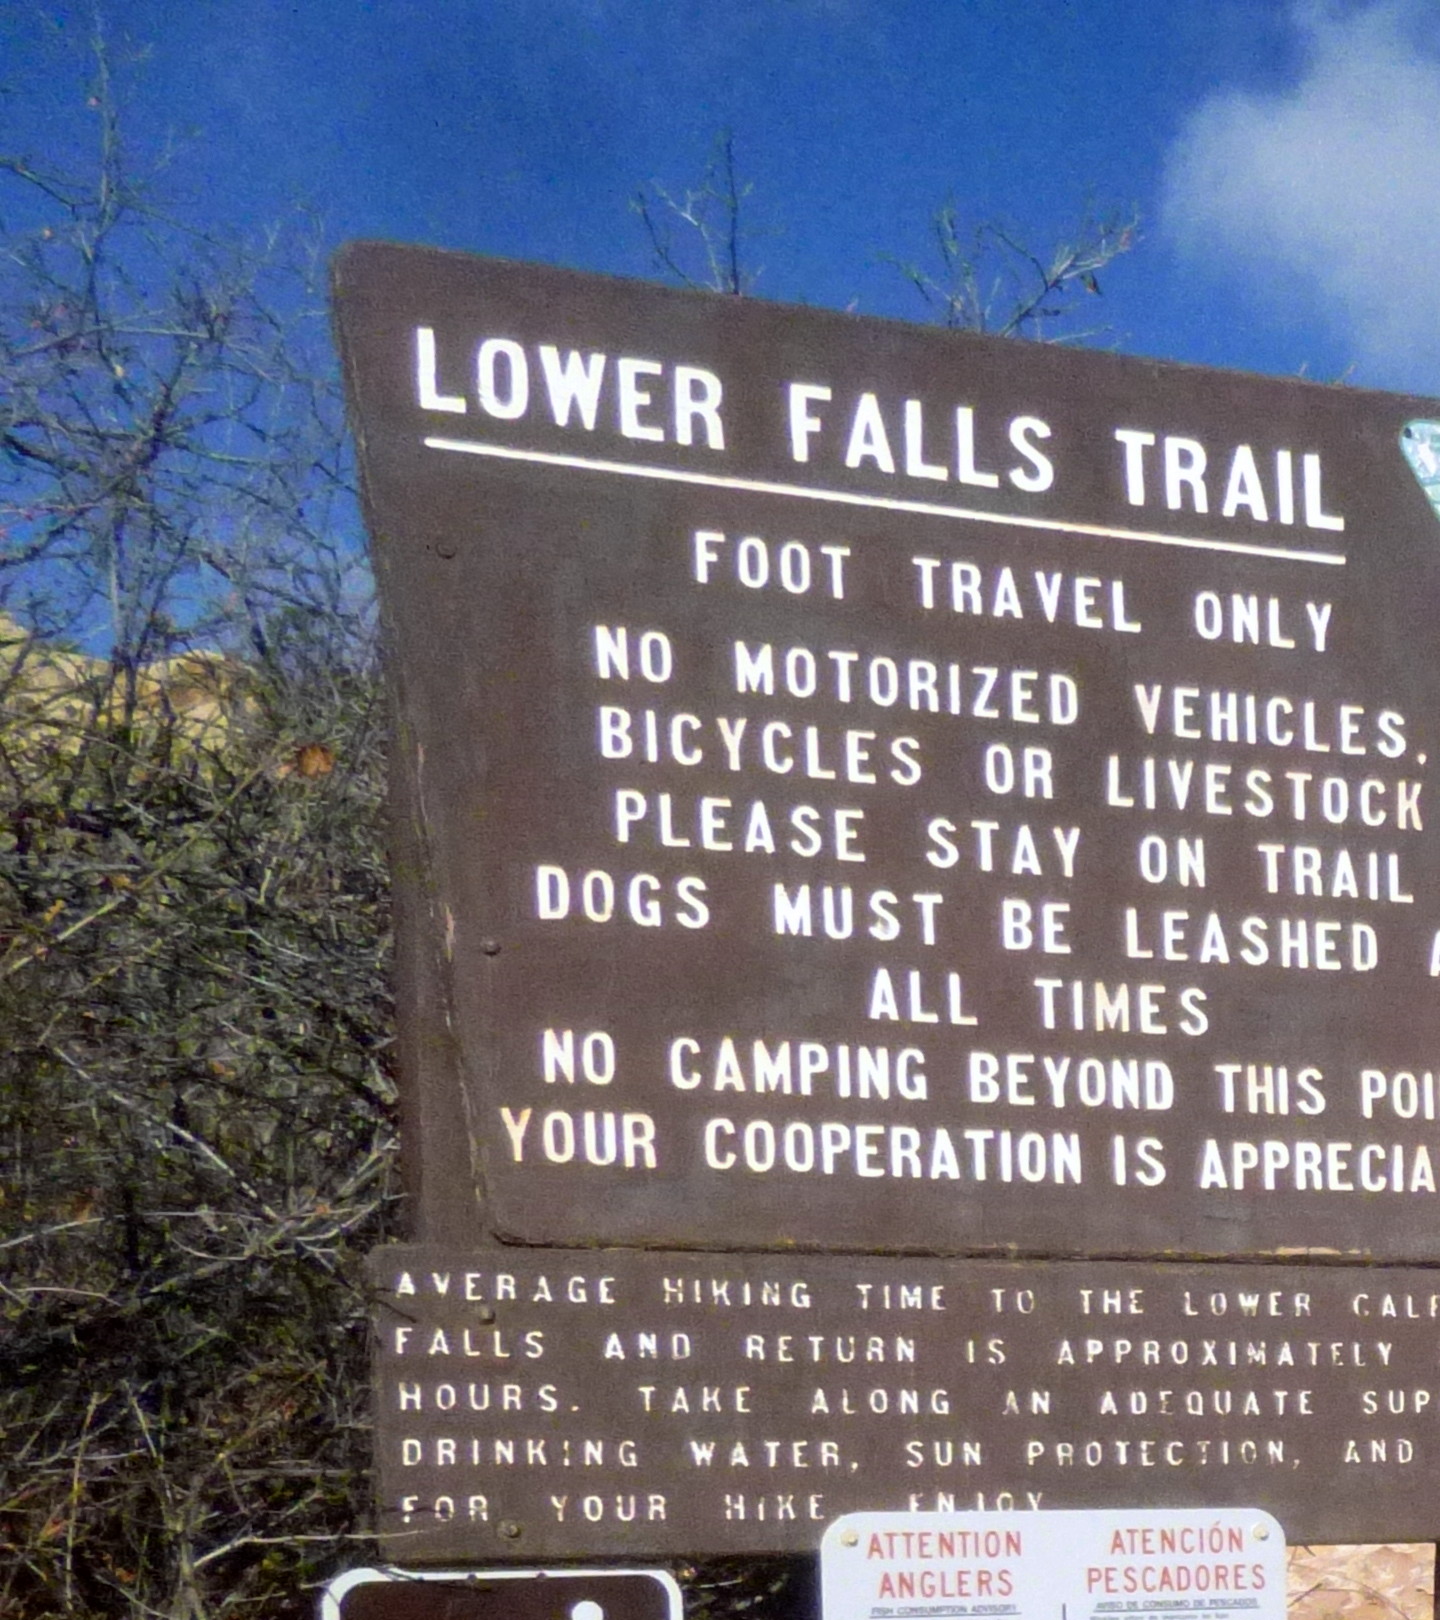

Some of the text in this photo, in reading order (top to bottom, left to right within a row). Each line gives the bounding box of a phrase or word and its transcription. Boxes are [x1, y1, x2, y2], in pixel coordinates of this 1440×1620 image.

[416, 327, 1344, 532] LOWER FALLS TRAIL
[694, 530, 1331, 652] FOOT TRAVEL ONLY
[595, 624, 672, 684] NO
[734, 642, 1077, 726] MOTORIZED
[601, 706, 1423, 831] BICYCLES OR LIVESTOCK
[616, 790, 1413, 902] PLEASE STAY ON TRAIL
[536, 864, 709, 929] DOGS
[773, 883, 942, 946] MUST
[1002, 898, 1071, 954] BE
[1125, 908, 1378, 970] LEASHED
[868, 968, 1208, 1035] ALL TIMES
[542, 1028, 615, 1085] NO
[669, 1036, 927, 1100] CAMPING
[968, 1050, 1173, 1109] BEYOND
[1214, 1064, 1326, 1115] THIS
[499, 1106, 656, 1168] YOUR
[704, 1117, 1081, 1183] COOPERATION
[1114, 1134, 1165, 1186] IS
[396, 1273, 615, 1304] AVERAGE
[663, 1278, 811, 1308] HIKING
[856, 1283, 946, 1310] TIME
[991, 1290, 1034, 1314] TO
[1080, 1289, 1144, 1315] THE
[1184, 1291, 1311, 1316] LOWER
[395, 1327, 544, 1359] FALLS
[604, 1333, 691, 1361] AND
[745, 1335, 915, 1363] RETURN
[967, 1339, 1005, 1364] IS
[1057, 1339, 1392, 1367] APPROXIMATELY
[399, 1383, 580, 1411] HOURS.
[638, 1386, 752, 1413] TAKE
[811, 1387, 949, 1415] ALONG
[1004, 1391, 1050, 1415] AN
[1100, 1390, 1313, 1416] ADEQUATE
[402, 1439, 638, 1467] DRINKING
[690, 1439, 859, 1471] WATER,
[905, 1442, 982, 1466] SUN
[1344, 1438, 1413, 1464] AND
[402, 1494, 489, 1523] FOR
[551, 1495, 666, 1520] YOUR
[725, 1495, 823, 1519] HIKE
[867, 1530, 1023, 1560] ATTENTION
[1110, 1521, 1244, 1556] ATENCIÓN
[878, 1569, 1015, 1600] ANGLERS
[1087, 1563, 1267, 1595] PESCADORES
